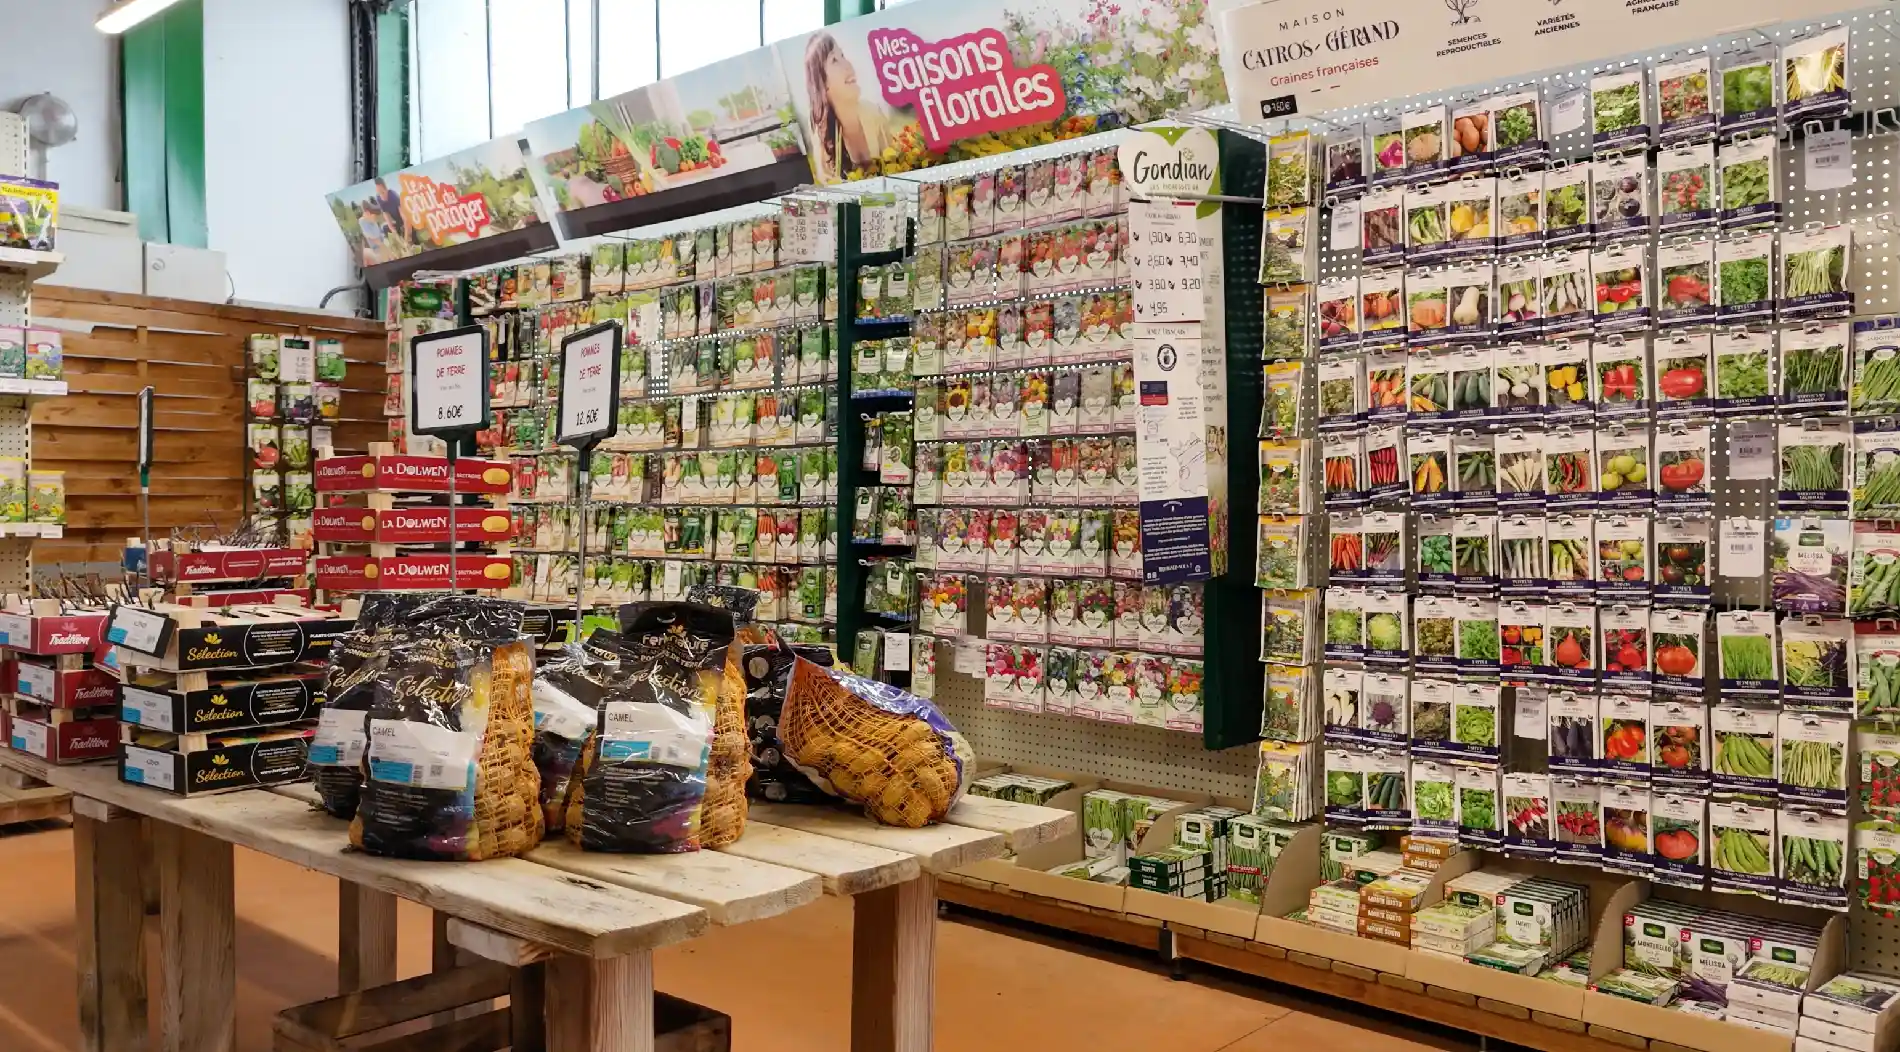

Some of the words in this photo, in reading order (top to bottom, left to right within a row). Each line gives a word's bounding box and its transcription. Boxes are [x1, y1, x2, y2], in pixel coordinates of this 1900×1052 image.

[1279, 8, 1345, 31] MAISON
[1536, 12, 1576, 27] VARIÉTÉS
[1534, 21, 1581, 37] ANCIENNES
[875, 36, 910, 58] Mes
[1436, 38, 1502, 58] REPRODUCTIBLES
[882, 36, 1003, 94] saisons
[1270, 71, 1315, 87] Graines
[1316, 56, 1380, 78] françaises
[919, 69, 1055, 142] florales
[1134, 150, 1213, 184] Gondian
[442, 187, 458, 205] du
[426, 199, 485, 240] potager
[1178, 231, 1197, 246] 6,30
[1182, 279, 1201, 291] 9,20
[436, 345, 463, 358] POMMES
[580, 343, 601, 358] POMMES
[436, 368, 445, 379] DE
[446, 364, 466, 377] TERRE
[586, 364, 602, 377] TERRE
[576, 409, 600, 426] 12.60€
[382, 466, 394, 475] LA
[396, 463, 448, 477] DOLWEN
[382, 520, 394, 528] LA
[396, 516, 447, 528] DOLWEN
[383, 567, 396, 575] LA
[399, 563, 450, 576] DOLWEN
[49, 633, 91, 646] Tradition
[187, 647, 238, 661] Sélection
[75, 686, 114, 699] Tradition
[194, 708, 244, 723] Sélection
[608, 713, 634, 723] CAMEL
[372, 726, 396, 738] CAMEL
[69, 737, 110, 750] Tradition
[196, 768, 244, 782] Sélection
[1700, 959, 1726, 969] MELISSA
